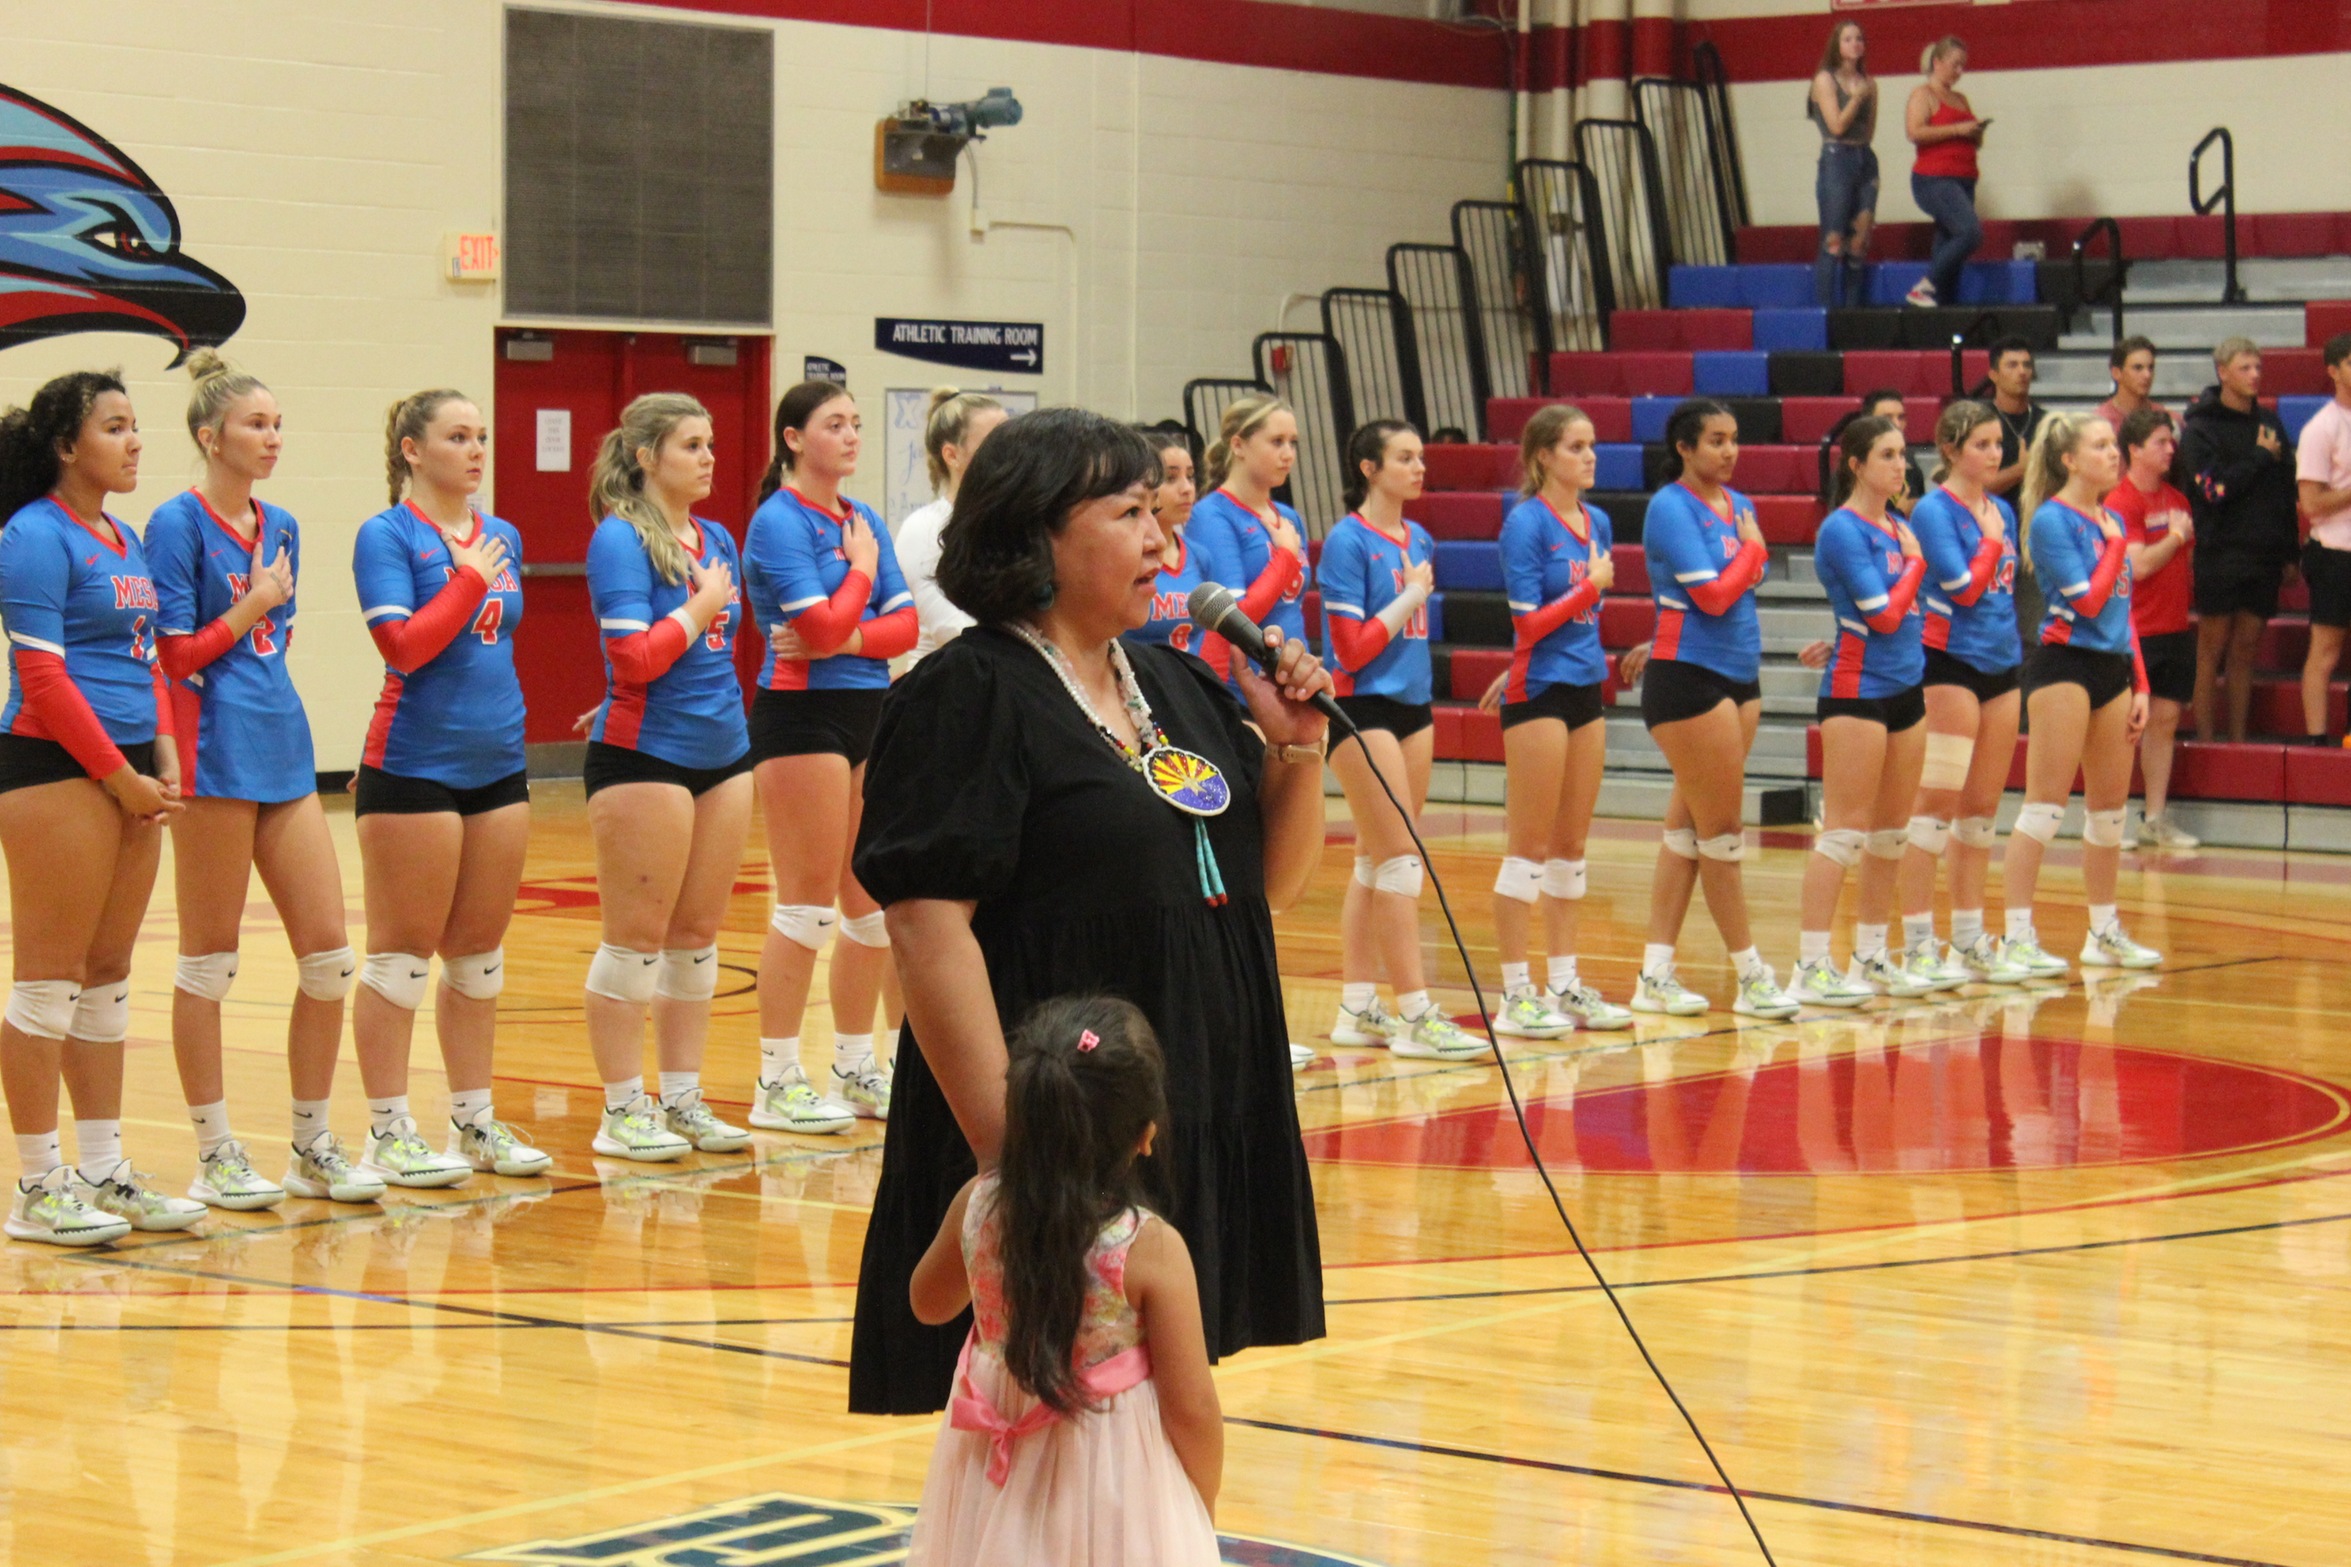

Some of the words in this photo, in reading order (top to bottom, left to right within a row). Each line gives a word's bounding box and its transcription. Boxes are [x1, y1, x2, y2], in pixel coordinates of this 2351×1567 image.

[460, 235, 493, 270] EXIT
[892, 323, 946, 343] ATHLETIC
[950, 326, 1001, 345] TRAINING
[1004, 328, 1038, 346] ROOM
[470, 598, 503, 645] 4
[1151, 592, 1191, 621] ME
[250, 613, 278, 657] 2
[705, 610, 731, 653] 5
